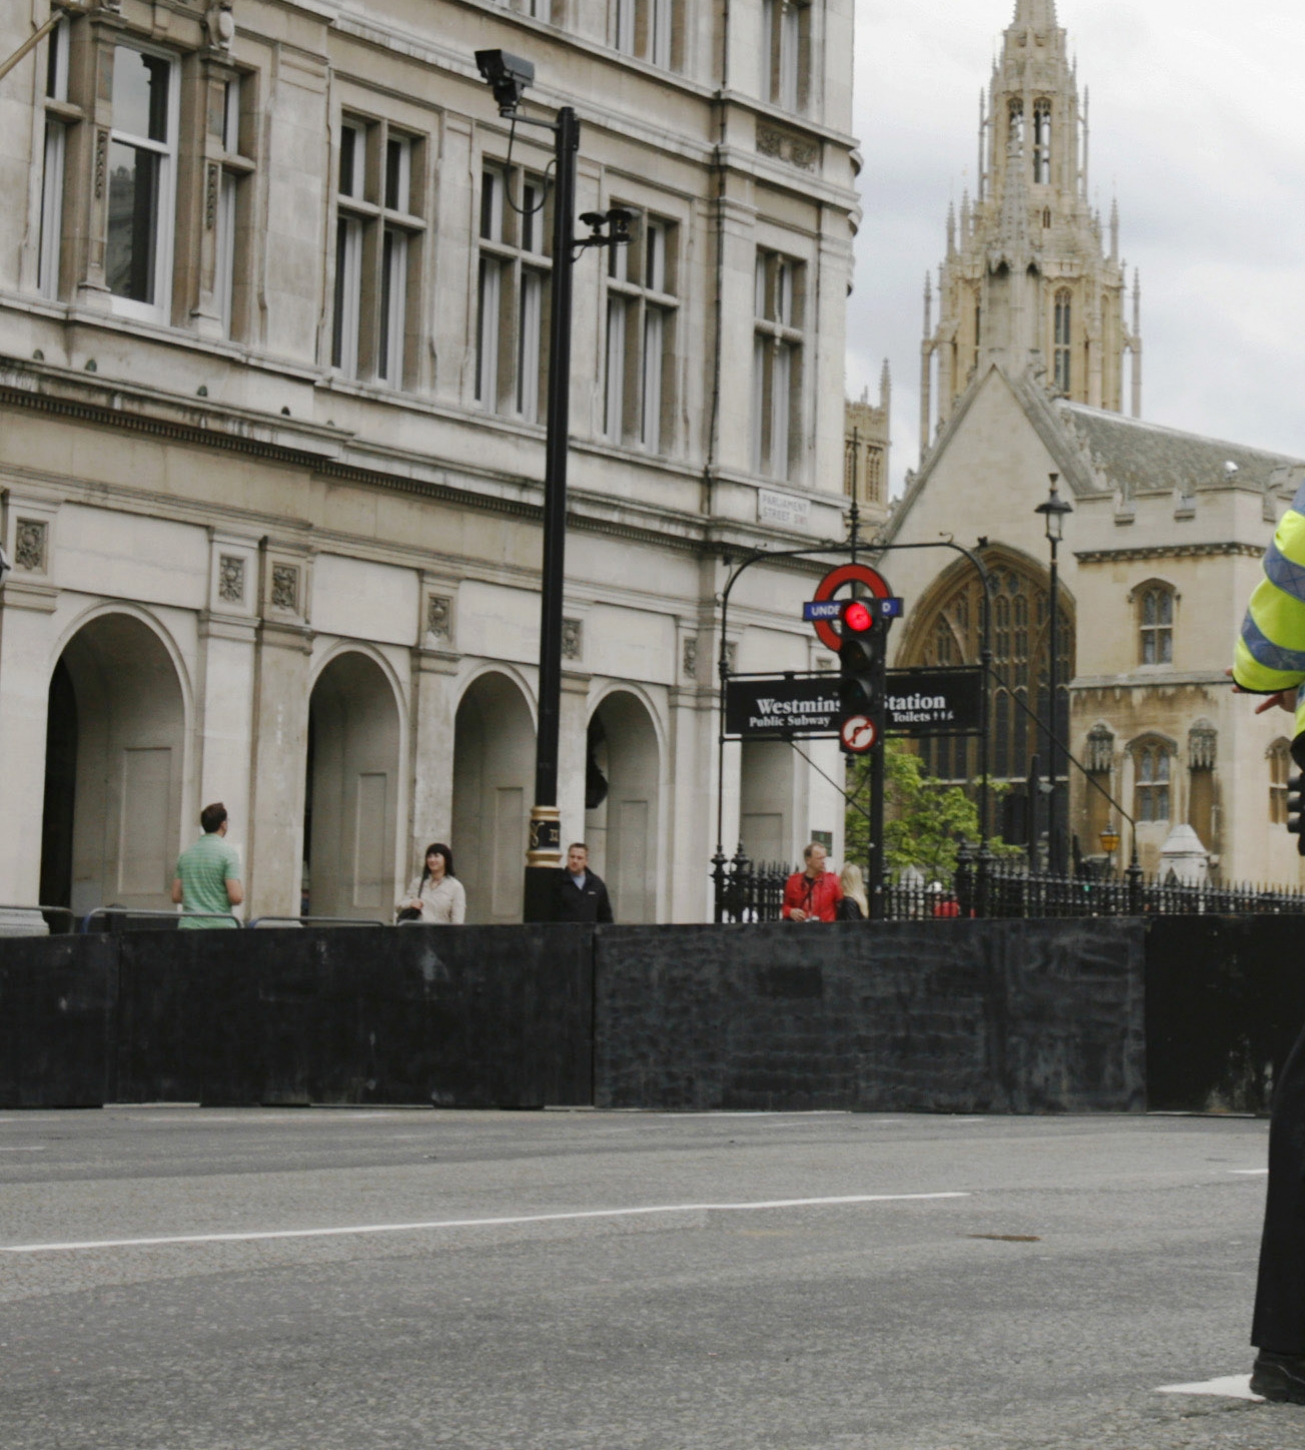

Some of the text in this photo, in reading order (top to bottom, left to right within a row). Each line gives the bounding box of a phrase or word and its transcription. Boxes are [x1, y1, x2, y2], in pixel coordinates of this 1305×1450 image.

[762, 494, 808, 513] PARLIAMENT
[763, 506, 791, 521] STREET
[749, 711, 931, 728] Public Subway Toilets
